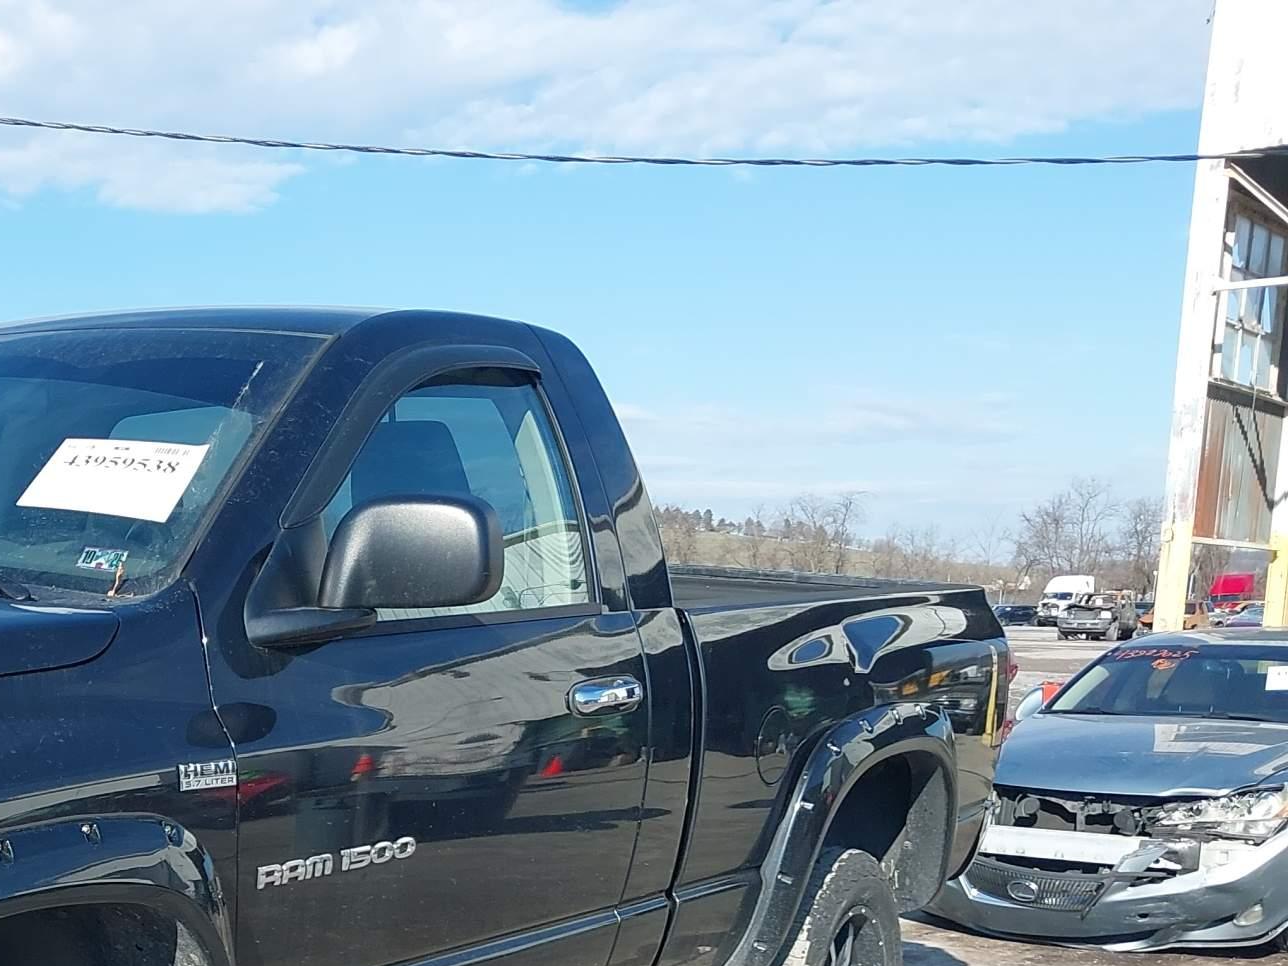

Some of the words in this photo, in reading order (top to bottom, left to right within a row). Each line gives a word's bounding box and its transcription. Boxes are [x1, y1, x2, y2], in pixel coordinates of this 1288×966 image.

[64, 455, 180, 473] 43959538
[183, 761, 235, 779] HEMI
[185, 780, 201, 788] 5.7
[204, 777, 234, 786] LITER
[257, 853, 333, 890] RAM
[341, 836, 417, 872] 1500
